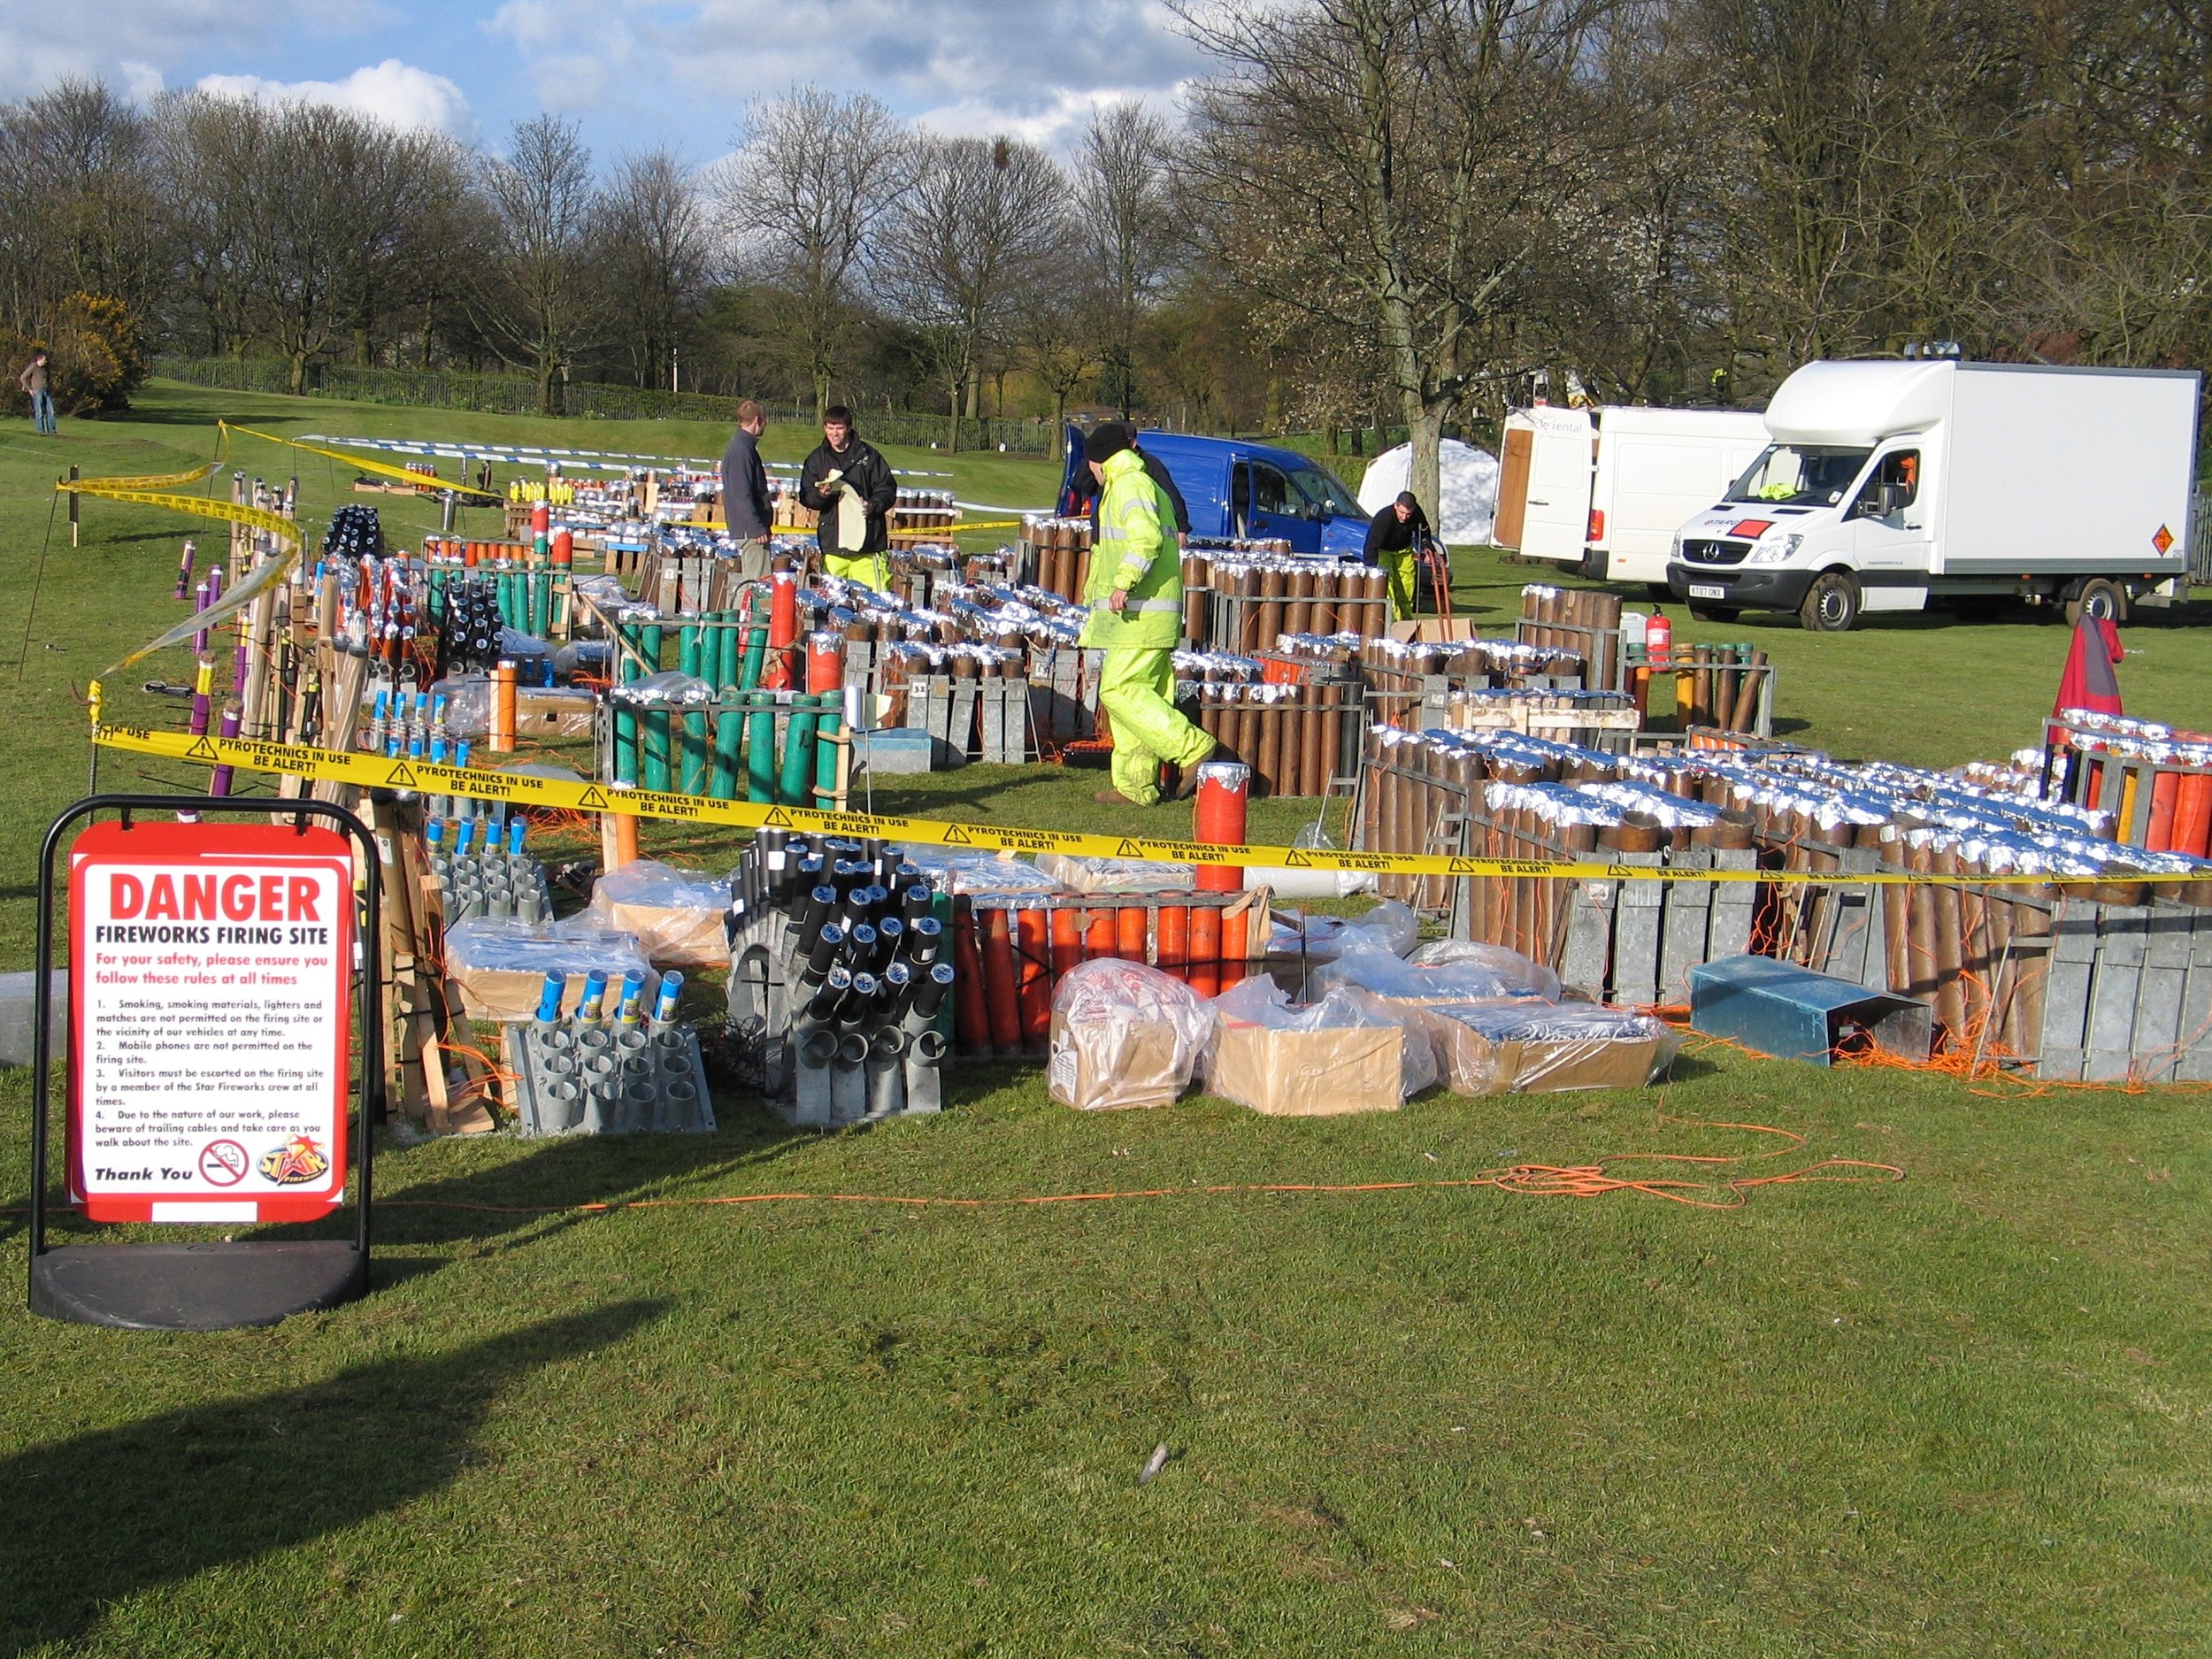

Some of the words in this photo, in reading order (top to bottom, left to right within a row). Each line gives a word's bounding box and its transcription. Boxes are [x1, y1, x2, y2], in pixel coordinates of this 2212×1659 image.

[1553, 423, 1582, 433] rental
[219, 739, 308, 759] PYROTECHNICS
[312, 751, 325, 762] IN
[328, 754, 350, 765] USE
[254, 755, 269, 765] BE
[273, 758, 316, 773] ALERT!
[417, 765, 503, 784] PYROTECHNICS
[507, 777, 518, 786] IN
[521, 778, 544, 789] USE
[450, 781, 465, 791] BE
[470, 783, 511, 796] ALERT!
[606, 789, 690, 805] PYROTECHNICS
[693, 797, 704, 807] IN
[708, 799, 729, 810] USE
[641, 802, 655, 811] BE
[658, 804, 699, 817] ALERT!
[790, 809, 871, 824] PYROTECHNICS
[873, 816, 885, 825] IN
[888, 818, 910, 827] USE
[824, 821, 839, 831] BE
[841, 823, 879, 834] ALERT!
[967, 826, 1045, 840] PYROTECHNICS
[1062, 833, 1082, 843] USE
[1000, 837, 1014, 846] BE
[1017, 839, 1056, 850] ALERT!
[1139, 841, 1216, 852] PYROTECHNICS
[1172, 850, 1186, 859] BE
[1188, 851, 1225, 862] ALERT!
[1305, 851, 1380, 860] PYROTECHNICS
[1339, 859, 1351, 868] BE
[1354, 860, 1391, 869] ALERT!
[110, 873, 320, 922] DANGER
[96, 926, 210, 944] FIREWORKS
[218, 927, 282, 944] FIRING
[288, 928, 328, 944] SITE
[96, 953, 118, 964] For
[122, 956, 151, 967] your
[157, 952, 202, 967] safety,
[206, 953, 250, 968] please
[256, 956, 299, 966] ensure
[304, 957, 327, 968] you
[96, 972, 137, 984] follow
[143, 972, 179, 984] these
[184, 972, 217, 984] rules
[222, 974, 235, 985] at
[240, 972, 257, 985] all
[261, 972, 297, 985] times
[97, 1000, 106, 1009] 1.
[119, 1000, 164, 1010] Smoking,
[167, 1000, 209, 1010] smoking
[211, 1000, 261, 1010] materials,
[265, 1000, 300, 1010] lighters
[304, 1000, 322, 1010] and
[96, 1013, 136, 1023] matches
[160, 1014, 175, 1023] not
[179, 1013, 227, 1025] permitted
[245, 1014, 260, 1023] the
[264, 1013, 289, 1025] firing
[293, 1014, 310, 1023] site
[96, 1027, 111, 1036] the
[116, 1027, 150, 1038] vicinity
[154, 1027, 163, 1036] of
[186, 1027, 224, 1036] vehicles
[241, 1029, 257, 1038] any
[261, 1028, 285, 1037] time.
[119, 1041, 152, 1049] Mobile
[156, 1041, 190, 1052] phones
[213, 1041, 228, 1050] not
[232, 1041, 280, 1052] permitted
[298, 1041, 312, 1050] the
[96, 1055, 122, 1065] firing
[127, 1055, 147, 1064] site.
[96, 1069, 105, 1078] 3.
[119, 1069, 155, 1078] Visitors
[186, 1069, 196, 1078] be
[201, 1069, 241, 1078] escorted
[259, 1069, 273, 1078] the
[278, 1069, 303, 1079] firing
[307, 1069, 323, 1078] site
[96, 1082, 107, 1093] by
[121, 1082, 160, 1091] member
[165, 1082, 173, 1091] of
[196, 1082, 215, 1091] Star
[219, 1082, 265, 1091] Fireworks
[306, 1082, 318, 1091] all
[153, 1110, 168, 1119] the
[206, 1110, 216, 1119] of
[239, 1110, 265, 1120] work,
[268, 1110, 299, 1121] please
[149, 1124, 184, 1134] trailing
[188, 1124, 218, 1133] cables
[221, 1124, 239, 1133] and
[242, 1124, 263, 1133] take
[122, 1138, 150, 1147] about
[154, 1138, 169, 1147] the
[173, 1138, 193, 1147] site.
[96, 1168, 153, 1180] Thank
[160, 1168, 193, 1180] You
